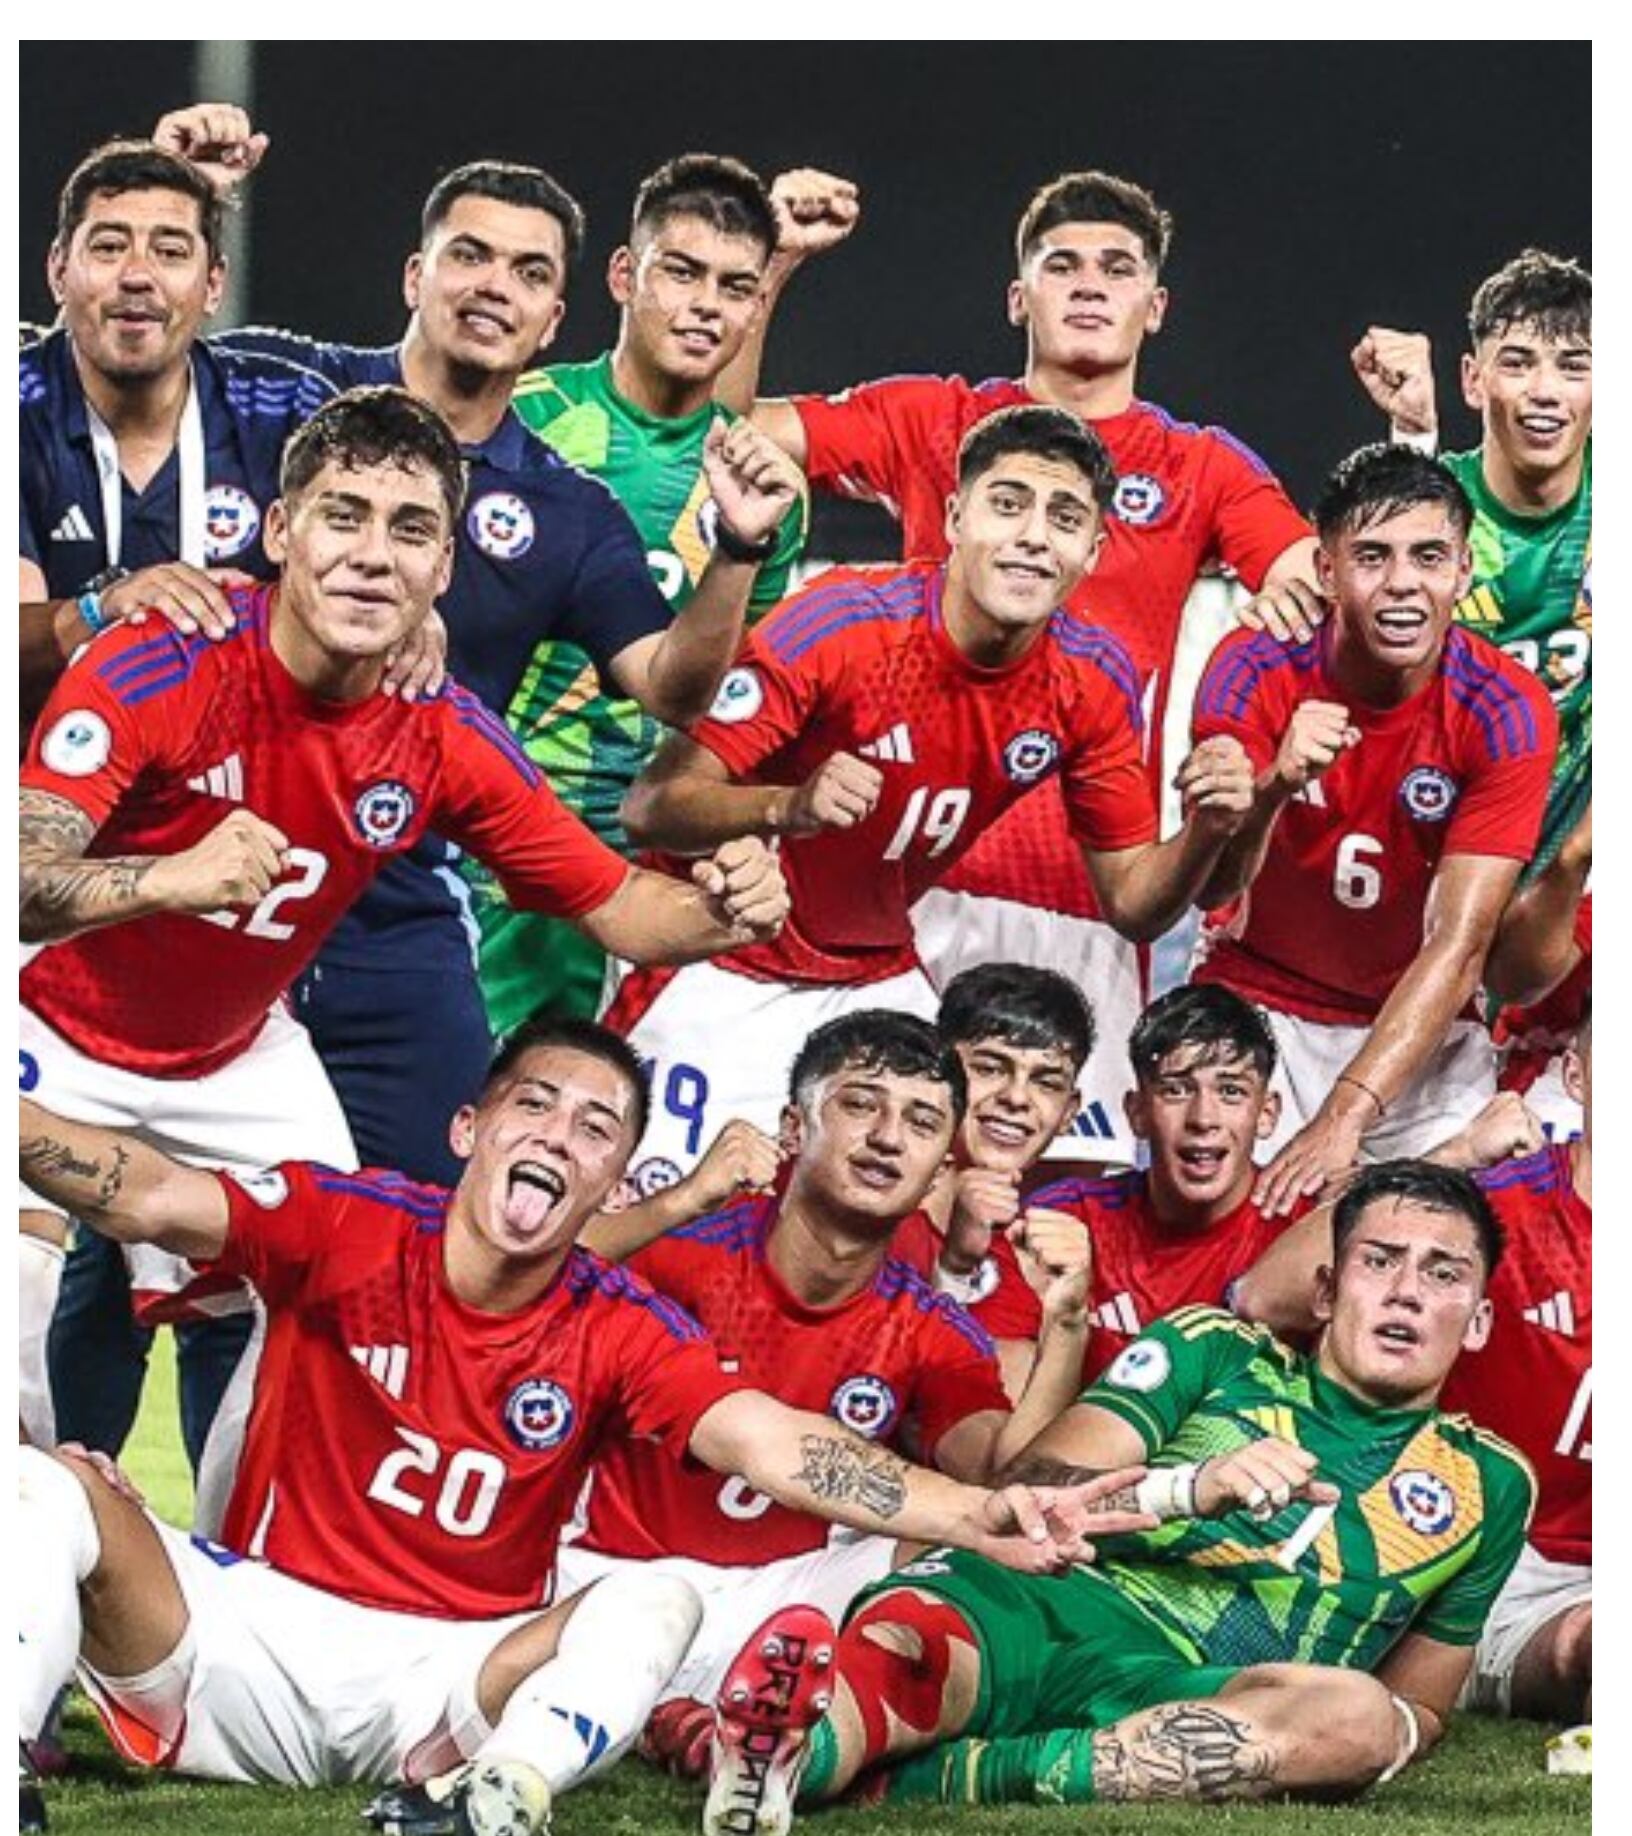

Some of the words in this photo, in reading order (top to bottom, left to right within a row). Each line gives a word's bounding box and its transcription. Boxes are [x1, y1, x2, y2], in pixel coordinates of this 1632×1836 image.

[882, 785, 971, 860] 19
[198, 848, 328, 940] 2
[1334, 832, 1384, 909] 6
[1554, 1367, 1592, 1460] 1
[367, 1425, 507, 1537] 20
